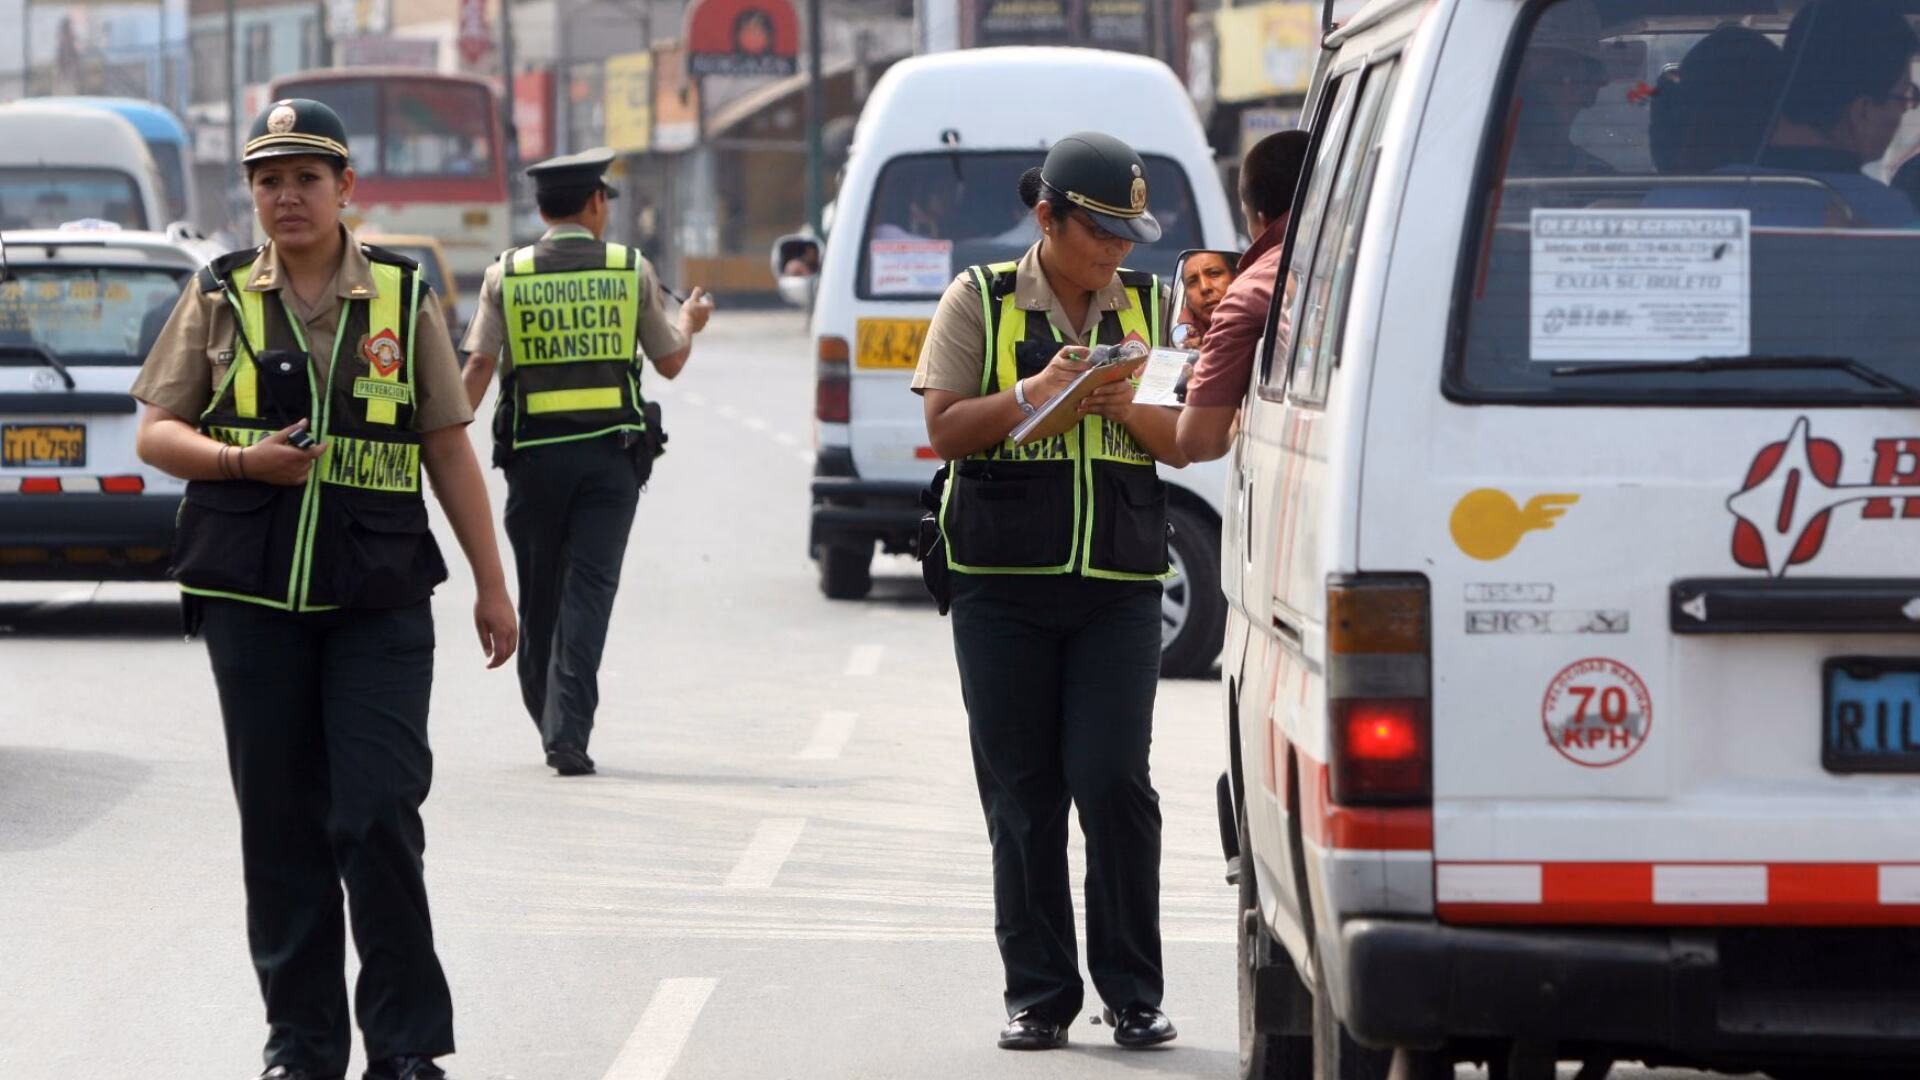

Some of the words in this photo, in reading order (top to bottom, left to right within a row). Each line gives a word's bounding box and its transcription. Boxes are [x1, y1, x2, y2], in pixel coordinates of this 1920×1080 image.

[513, 278, 628, 306] ALCOHOLEMIA
[1615, 273, 1641, 289] SU
[1645, 273, 1723, 290] BOLETO
[520, 304, 622, 333] POLICIA
[520, 332, 622, 360] TRANSITO
[329, 437, 412, 488] NACIONAL
[1465, 609, 1630, 635] HOY
[1568, 685, 1629, 726] 70
[1562, 726, 1631, 750] KPH
